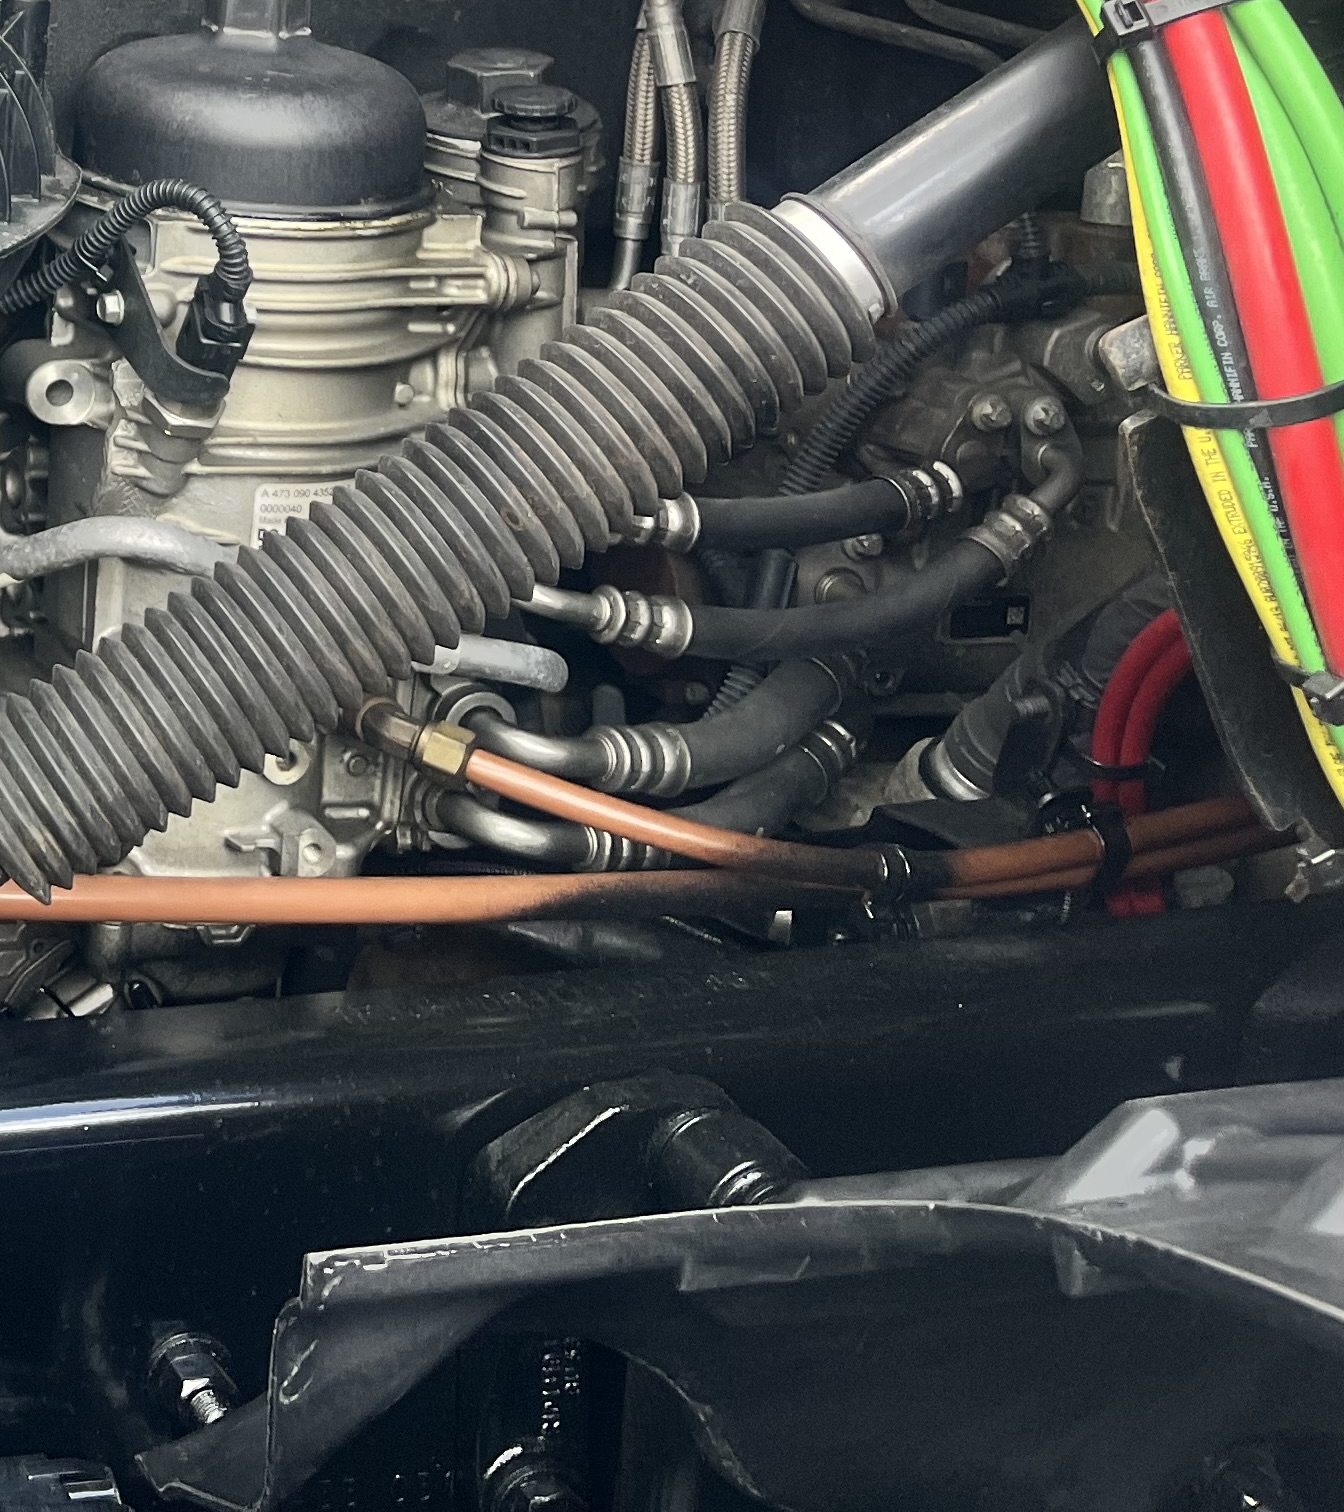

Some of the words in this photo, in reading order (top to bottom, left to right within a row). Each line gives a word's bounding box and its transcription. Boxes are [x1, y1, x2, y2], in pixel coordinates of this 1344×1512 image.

[1203, 286, 1219, 309] AIR
[1212, 314, 1229, 347] CORP.
[1168, 342, 1193, 380] PARKER
[1200, 447, 1220, 468] THE
[1212, 470, 1227, 483] IN
[260, 489, 269, 498] A
[272, 489, 291, 498] 473
[293, 488, 311, 498] 090
[259, 504, 303, 514] 0000040
[1218, 489, 1248, 535] EXTRUDED
